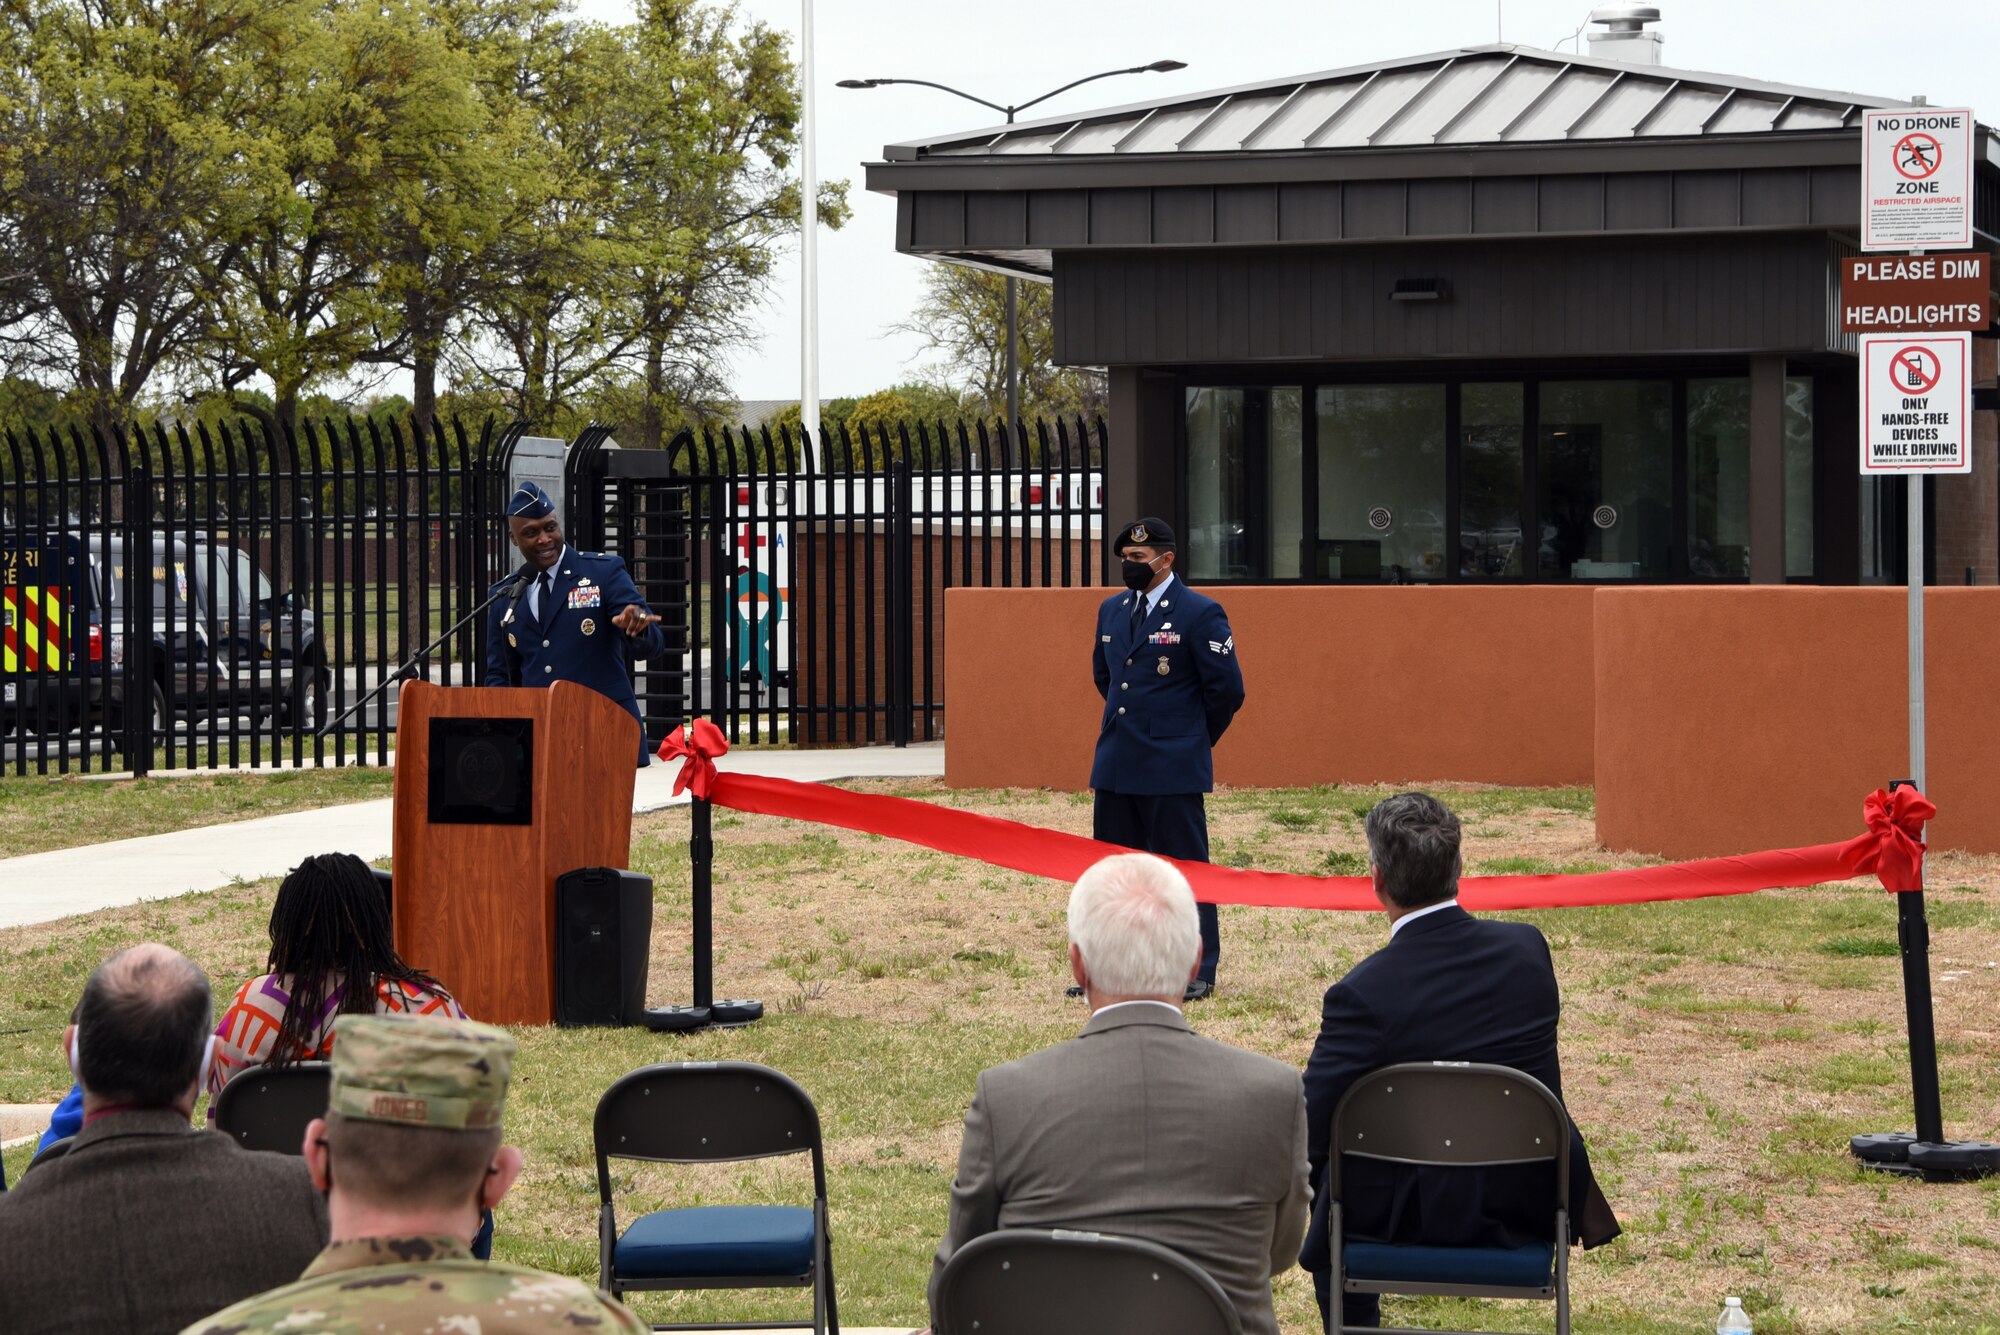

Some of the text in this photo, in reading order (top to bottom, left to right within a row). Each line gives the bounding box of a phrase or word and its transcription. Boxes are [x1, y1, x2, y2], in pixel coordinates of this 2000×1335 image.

[1877, 117, 1960, 131] NO DRONE
[1896, 181, 1939, 194] ZONE
[1873, 196, 1962, 206] RESTRICTED AIRSPACE
[1853, 259, 1980, 281] PLEASE DIM
[1846, 304, 1981, 325] HEADLIGHTS
[1902, 398, 1928, 410] ONLY
[1882, 413, 1949, 425] HANDS-FREE
[1892, 428, 1938, 440] DEVICES
[1873, 443, 1957, 456] WHILE DRIVING
[367, 1096, 428, 1121] JONES
